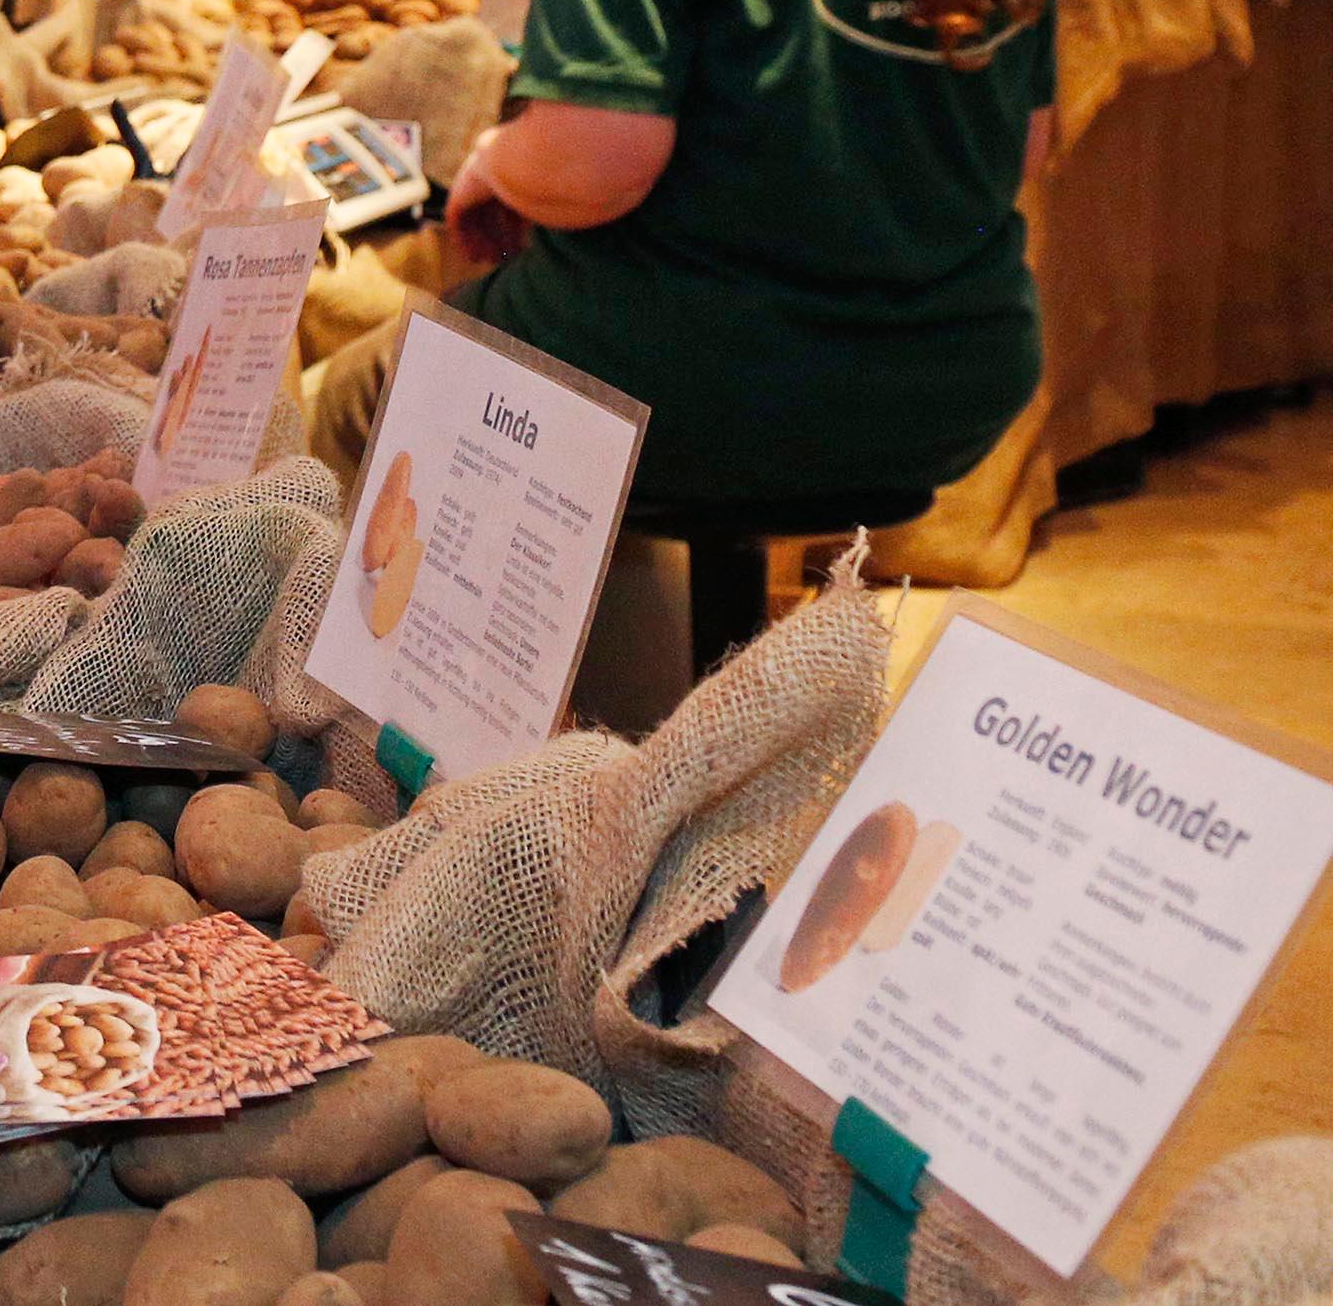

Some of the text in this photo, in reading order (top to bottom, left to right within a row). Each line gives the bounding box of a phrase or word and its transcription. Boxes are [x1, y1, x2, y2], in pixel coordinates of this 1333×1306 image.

[482, 391, 539, 451] Linda
[973, 695, 1096, 786] Golden
[1102, 756, 1252, 860] Wonder
